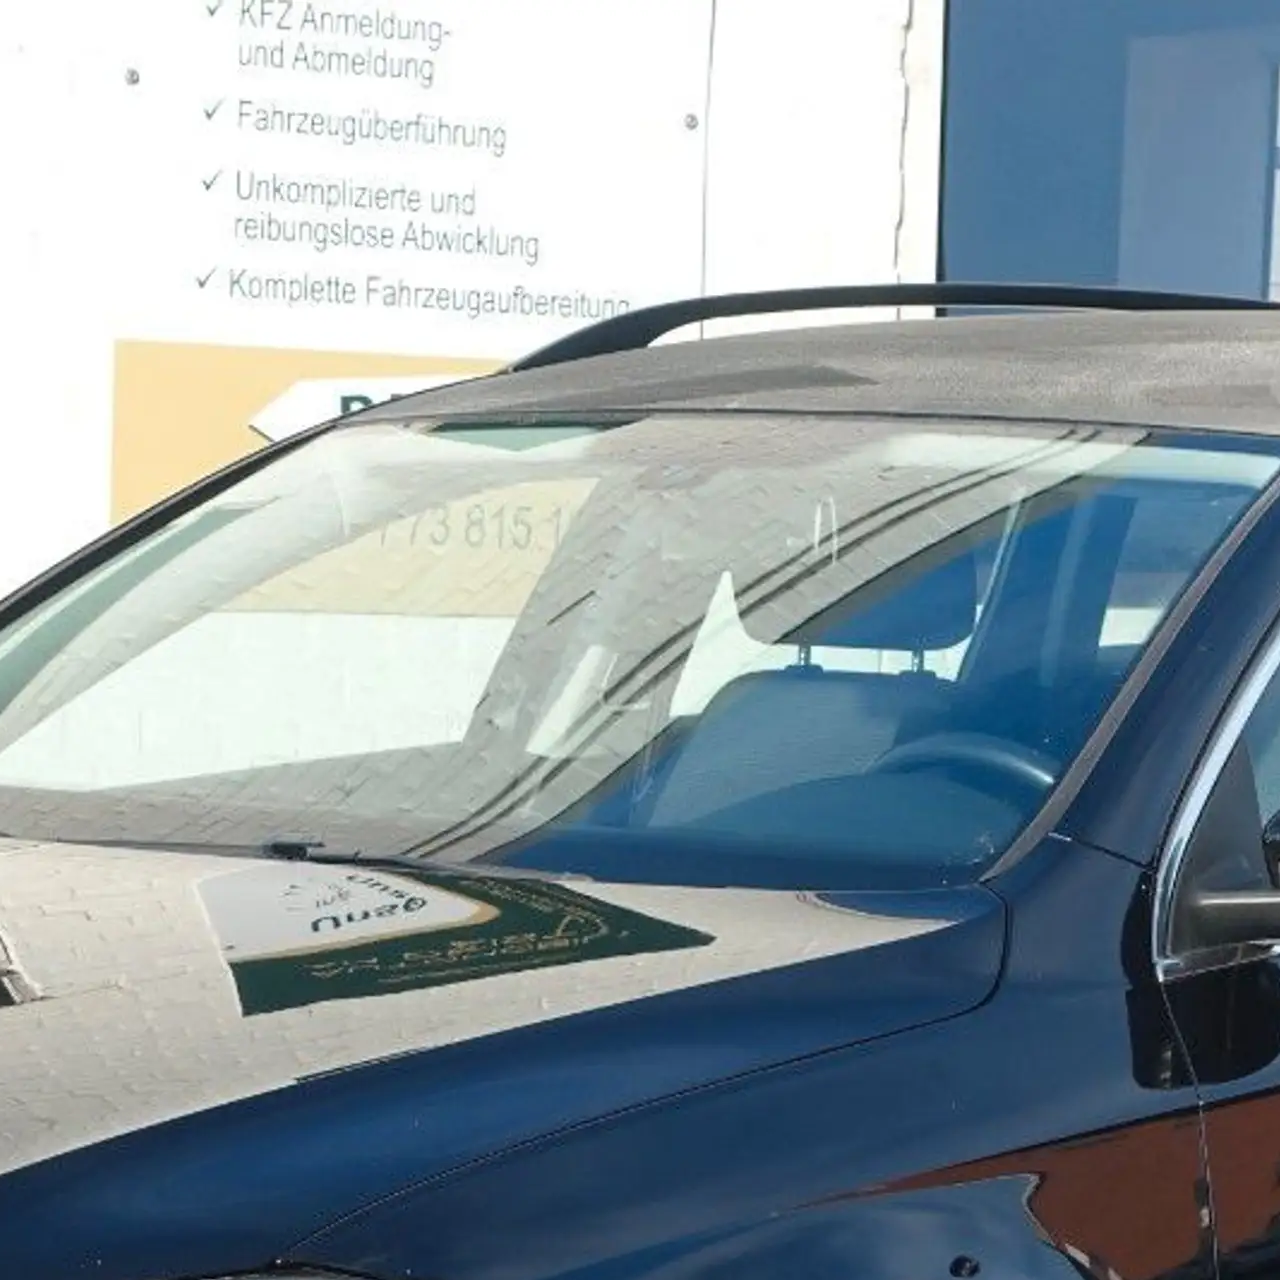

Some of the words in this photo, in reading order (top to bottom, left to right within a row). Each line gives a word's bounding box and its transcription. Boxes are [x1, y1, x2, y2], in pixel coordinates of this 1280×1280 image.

[239, 0, 292, 30] KFZ
[300, 3, 453, 52] Anmeldung-
[238, 40, 284, 69] und
[292, 41, 434, 89] Abmeldung
[237, 99, 506, 156] Fahrzeugüberführung
[236, 170, 421, 212] Unkomplizierte
[430, 188, 476, 217] und
[233, 212, 394, 253] reibungslose
[401, 220, 540, 267] Abwicklung
[228, 268, 356, 305] Komplette
